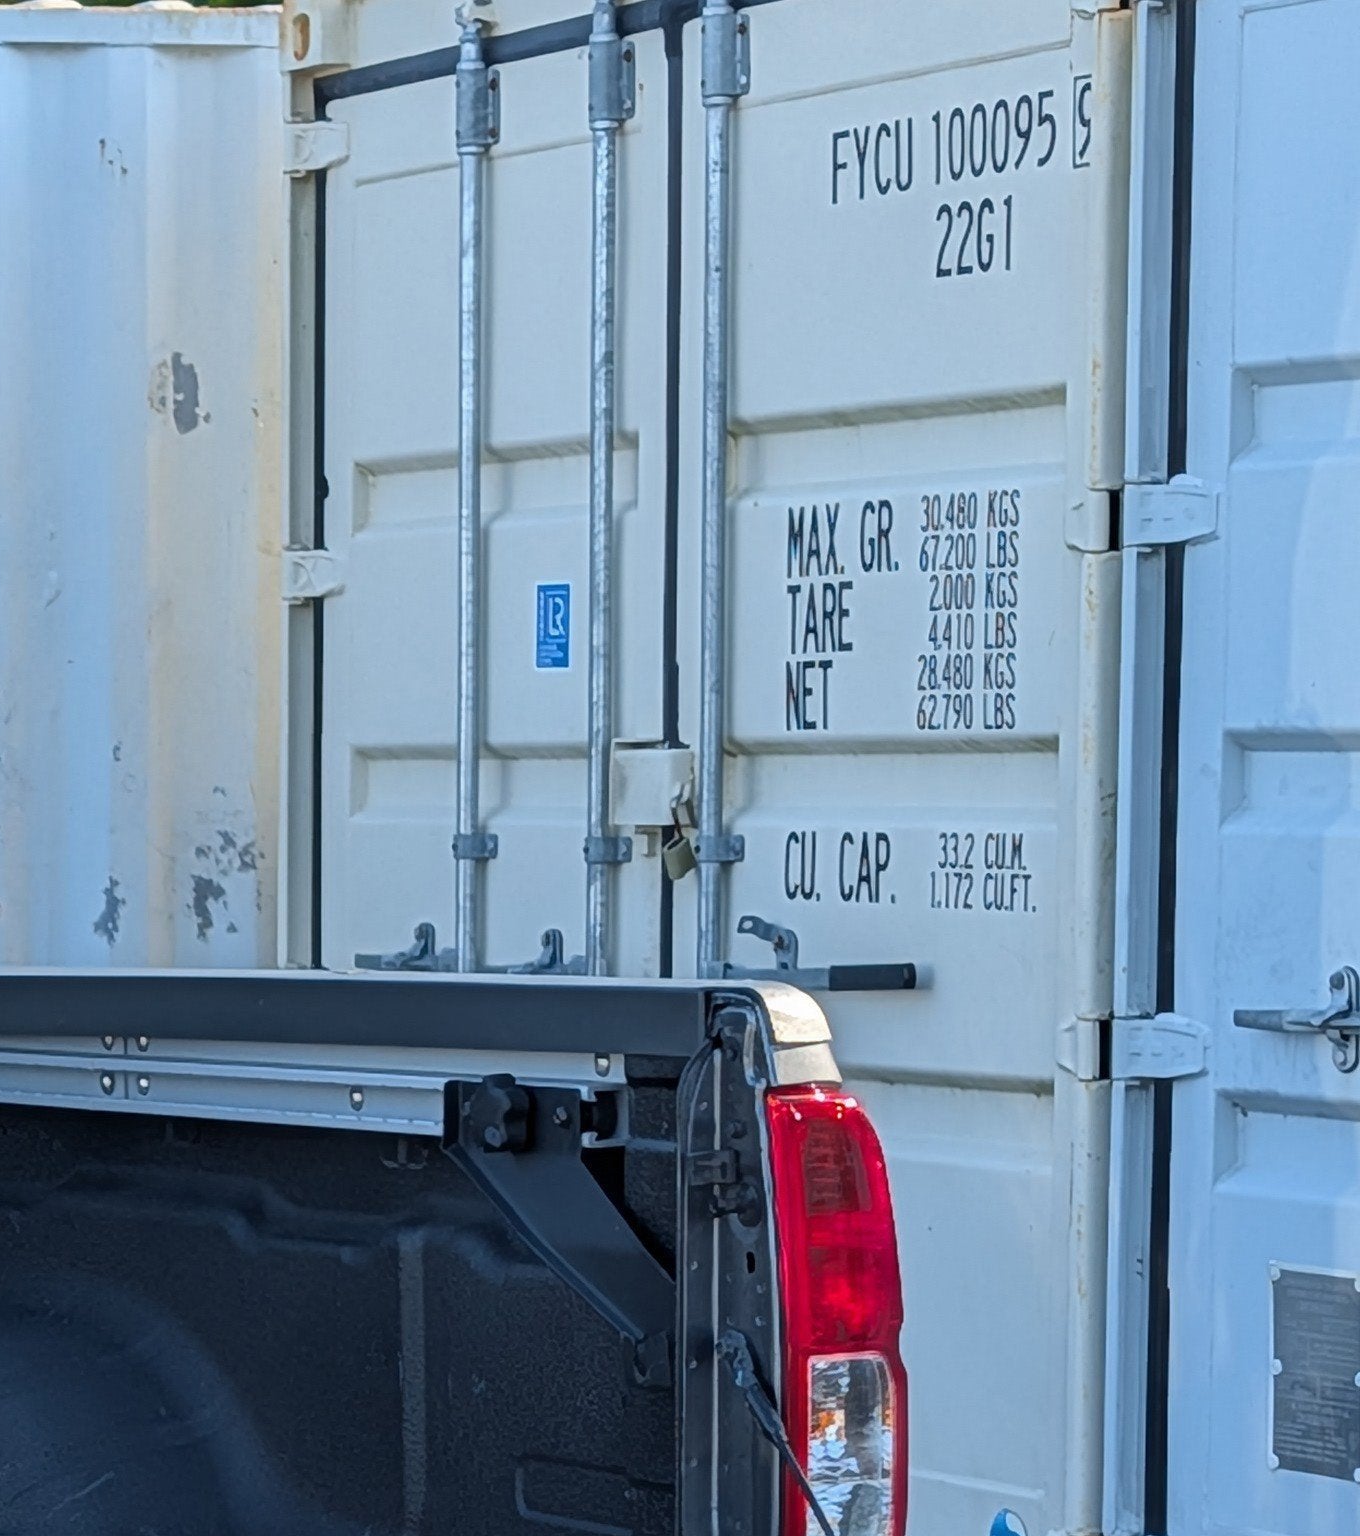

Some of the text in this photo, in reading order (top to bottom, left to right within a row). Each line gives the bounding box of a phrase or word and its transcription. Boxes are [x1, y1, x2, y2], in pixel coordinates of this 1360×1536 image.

[831, 117, 914, 205] FYCU
[932, 90, 1057, 185] 100095
[936, 194, 1013, 278] 22G1
[787, 502, 845, 579] MAX.
[860, 499, 900, 573] GR.
[987, 489, 1021, 529] KGS
[985, 530, 1020, 568] LBS
[787, 580, 853, 654] TARE
[984, 571, 1018, 610] KGS
[983, 611, 1018, 650] LBS
[785, 659, 834, 731] NET
[983, 652, 1017, 691] KGS
[982, 692, 1016, 730] LBS
[784, 830, 821, 902] CU.
[838, 831, 897, 904] CAP.
